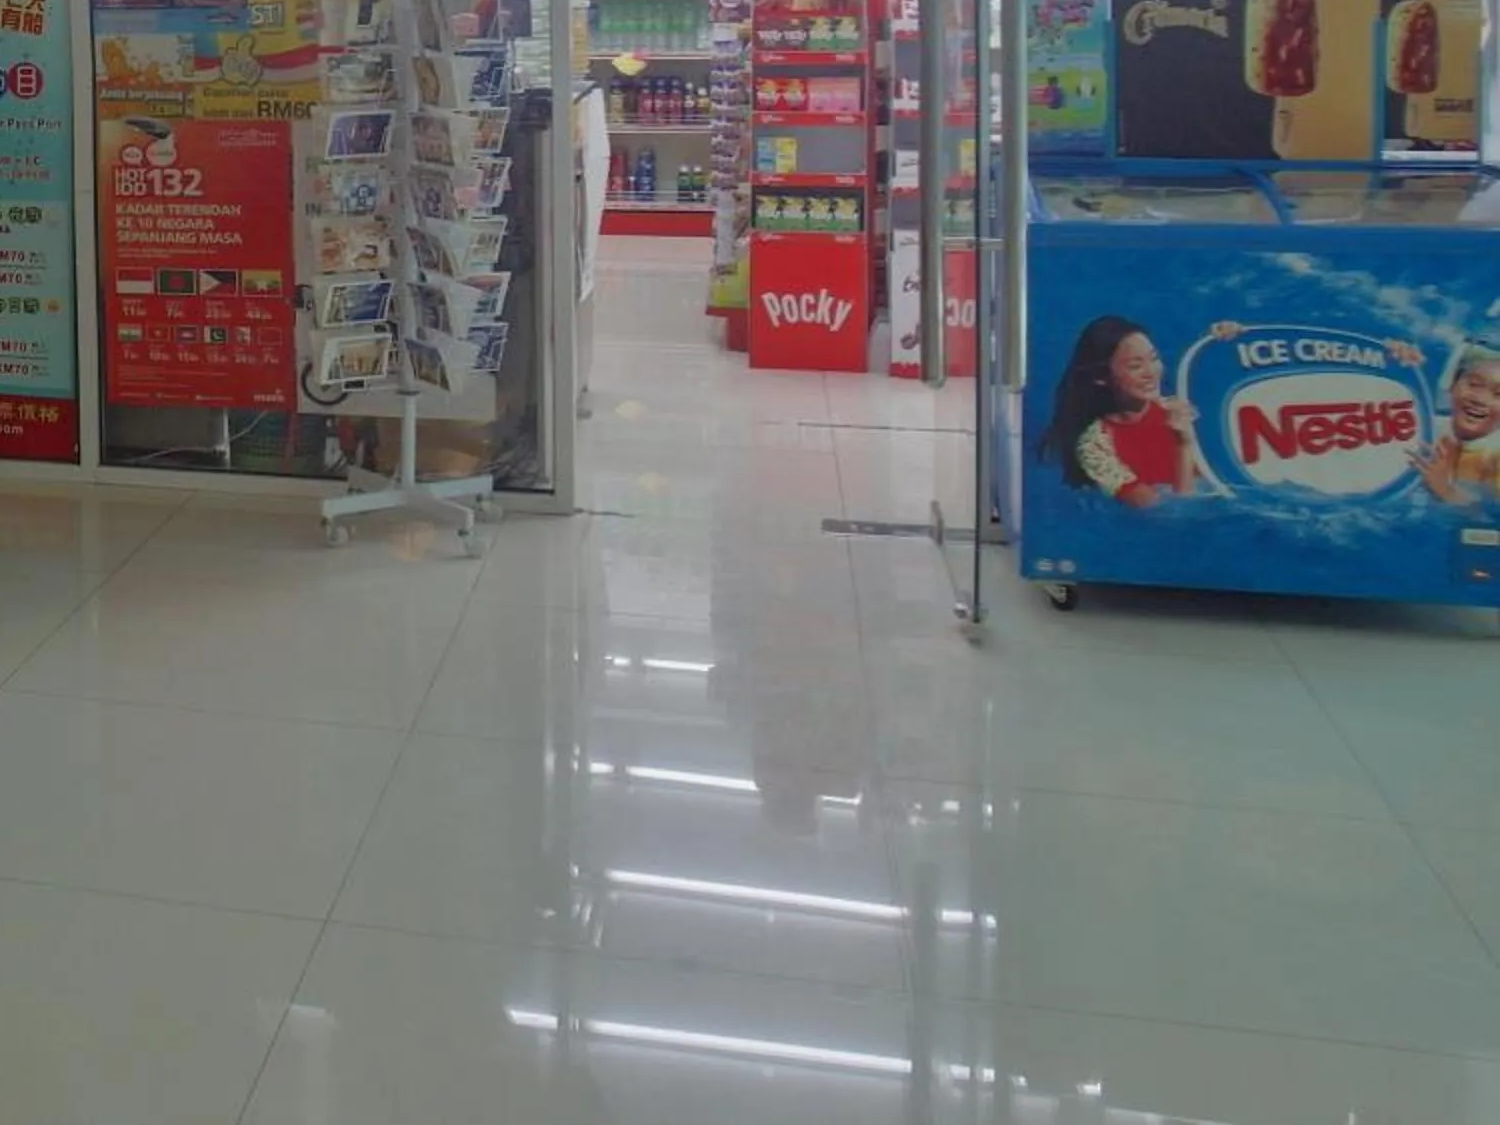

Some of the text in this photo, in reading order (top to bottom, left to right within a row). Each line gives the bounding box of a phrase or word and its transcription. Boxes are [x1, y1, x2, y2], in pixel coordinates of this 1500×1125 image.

[147, 168, 204, 196] 132
[200, 232, 243, 244] MASA
[1237, 337, 1386, 368] ICE CREAM
